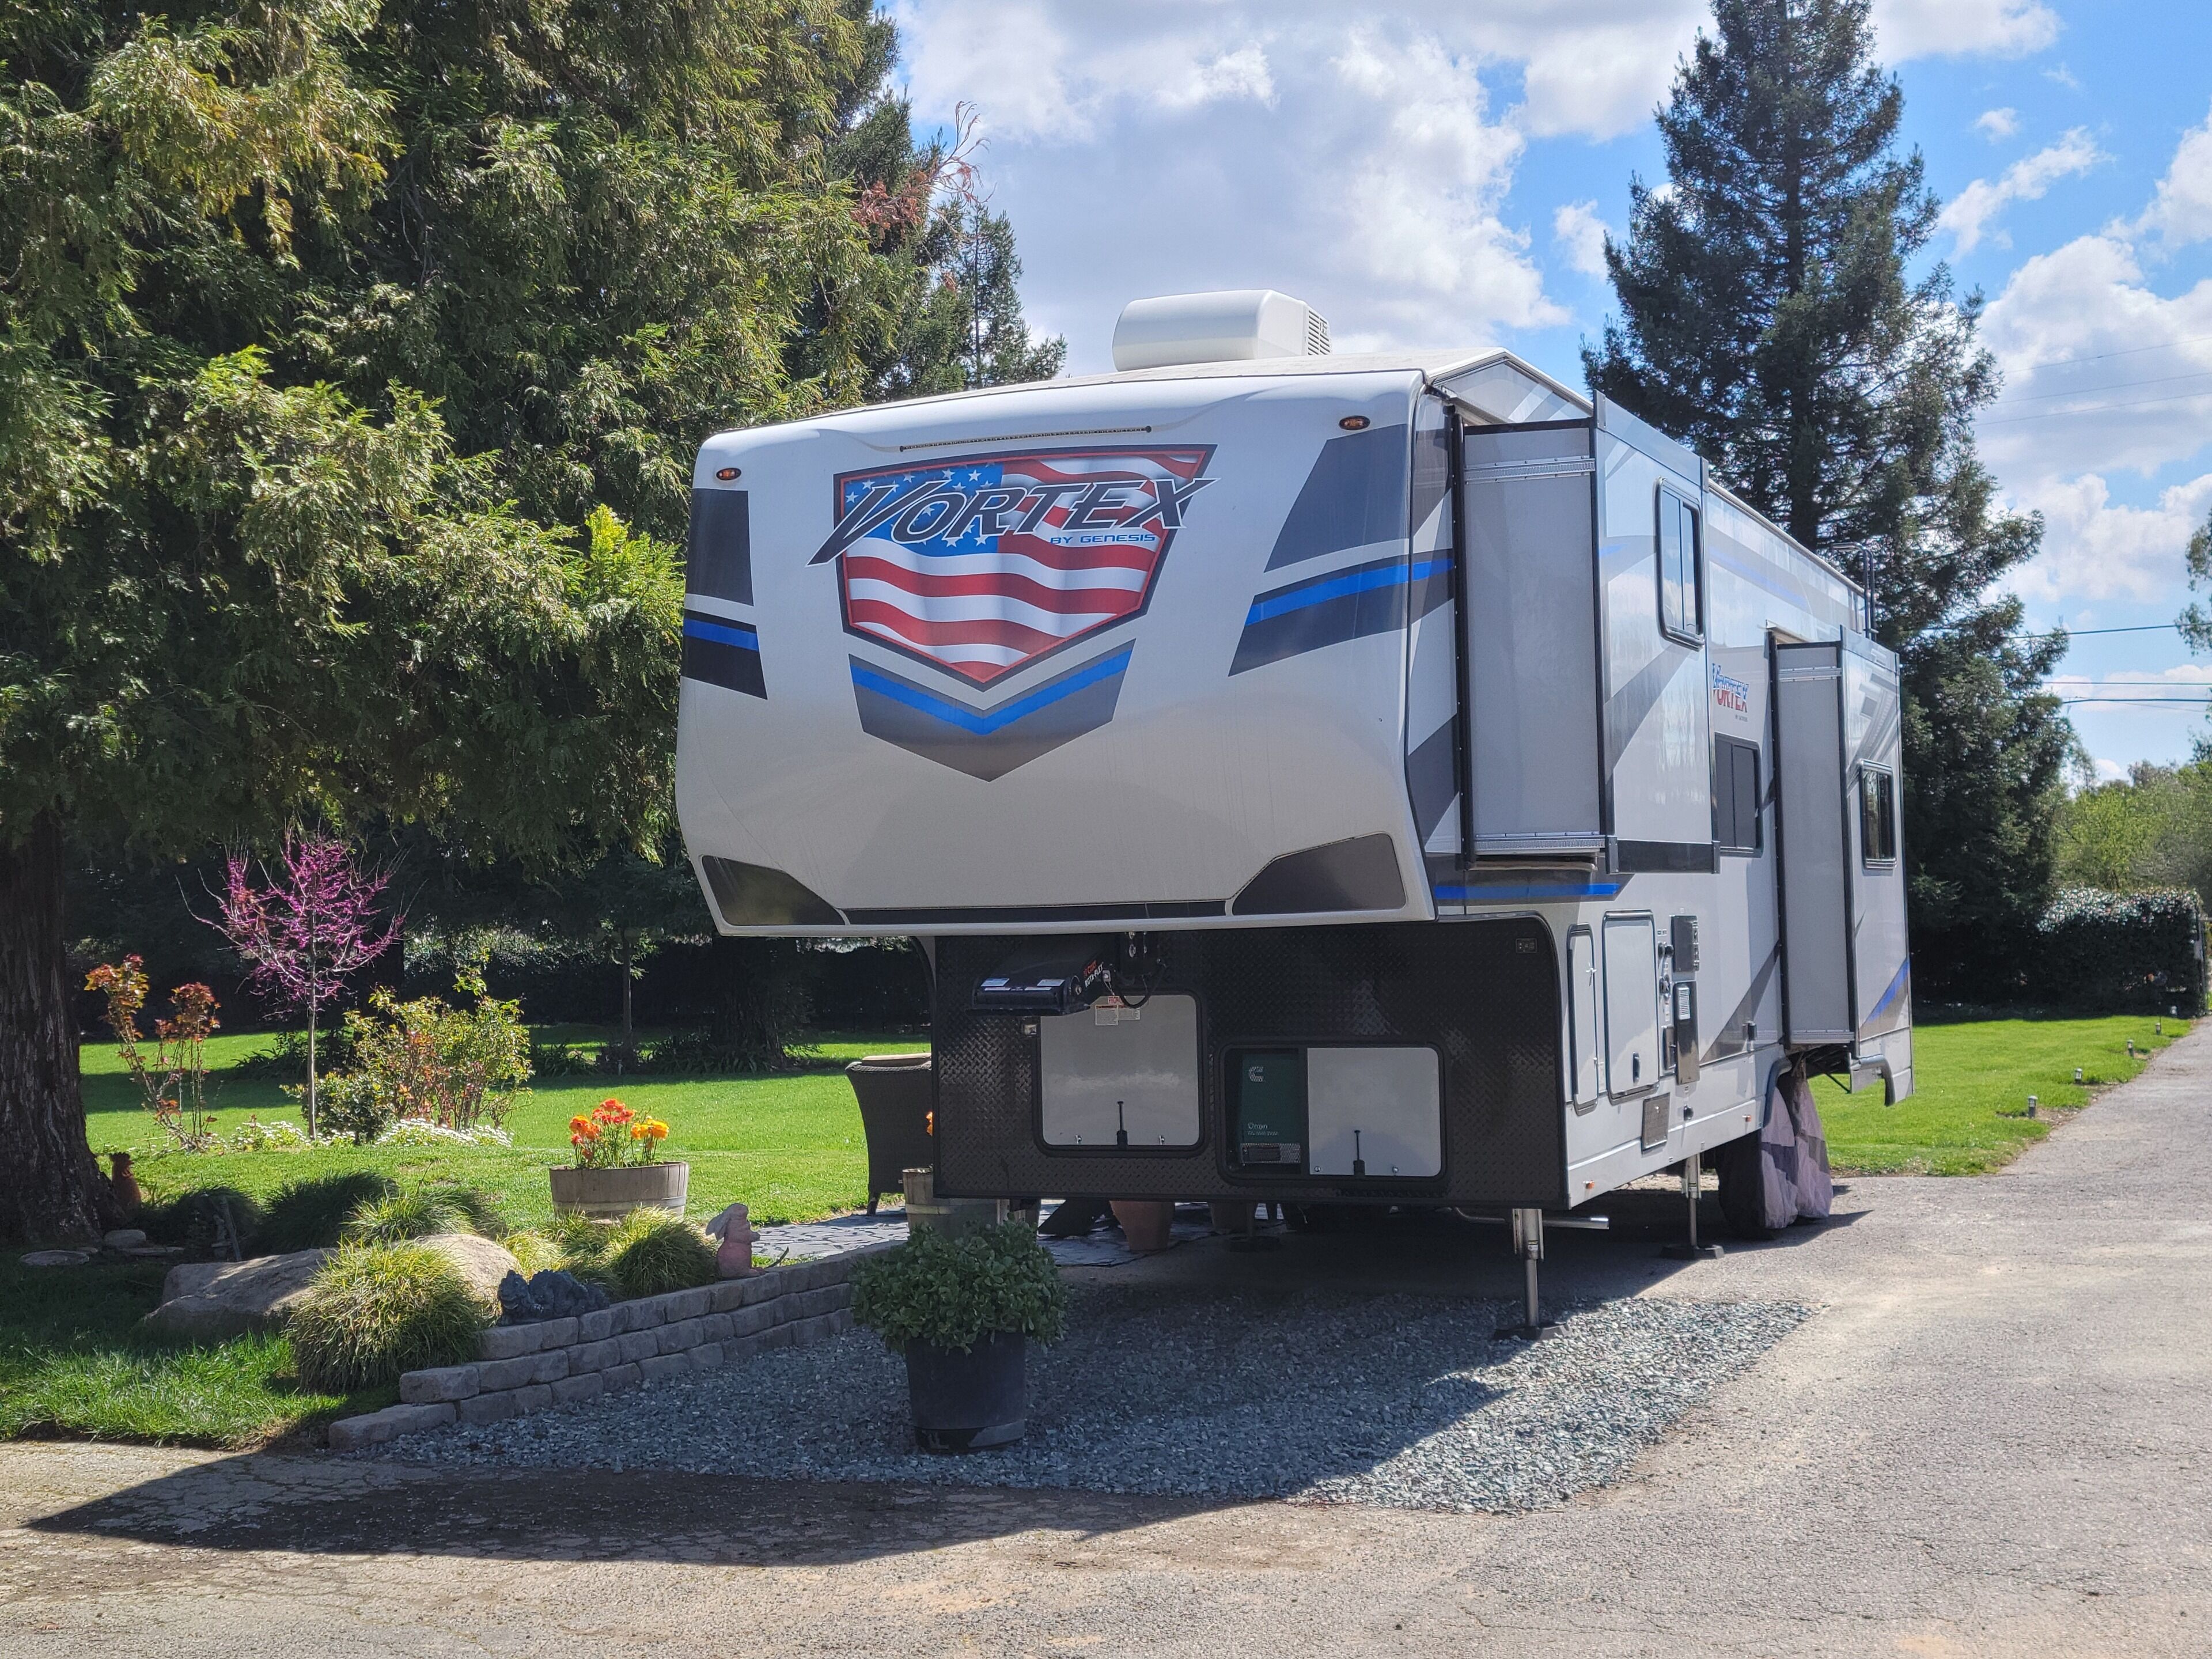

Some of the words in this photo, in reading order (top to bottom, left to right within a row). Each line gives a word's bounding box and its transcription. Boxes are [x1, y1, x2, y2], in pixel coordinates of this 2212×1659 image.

[807, 478, 1221, 566] VORTEX
[1050, 536, 1073, 544] BY
[1080, 534, 1156, 543] GENESIS
[1712, 663, 1749, 713] VORTEX
